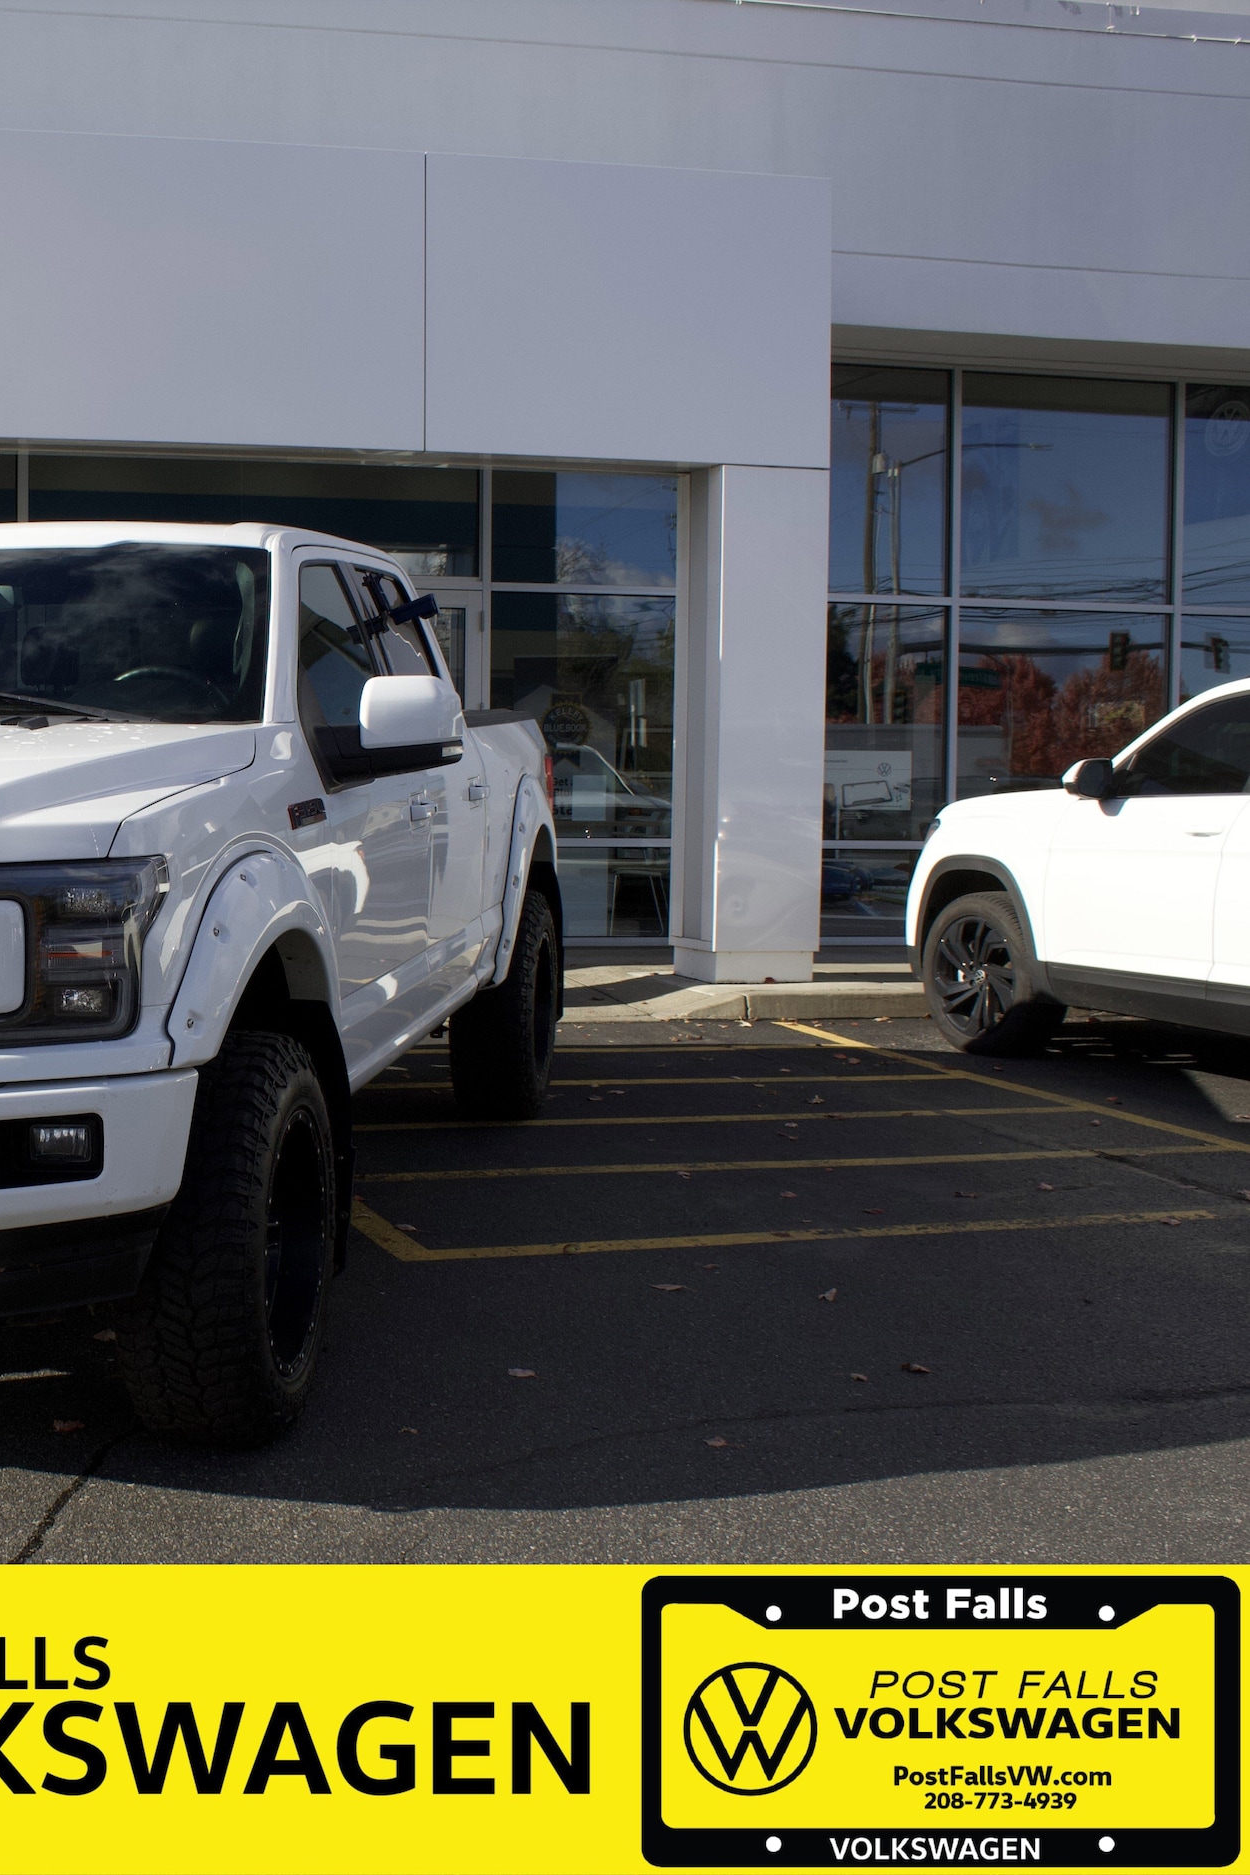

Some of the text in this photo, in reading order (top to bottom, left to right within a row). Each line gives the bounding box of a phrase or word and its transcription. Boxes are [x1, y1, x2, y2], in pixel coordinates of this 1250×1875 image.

[549, 706, 584, 721] KELLEY
[543, 723, 587, 732] BLUE BOOK
